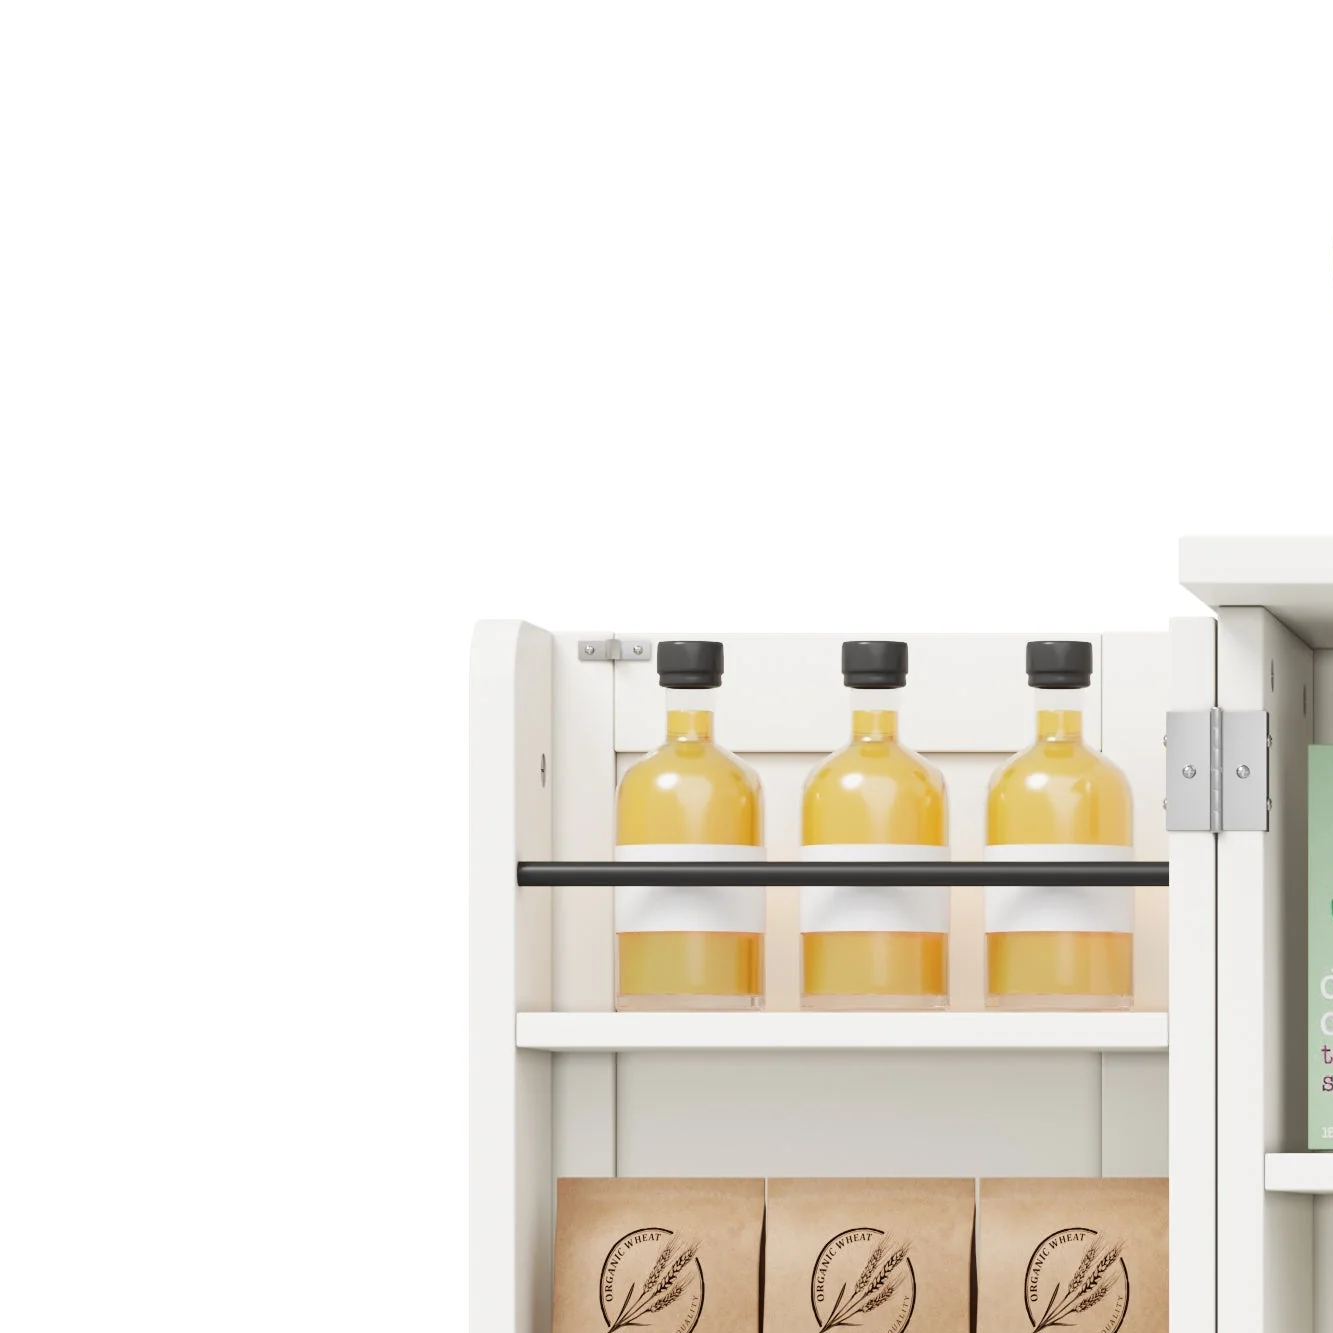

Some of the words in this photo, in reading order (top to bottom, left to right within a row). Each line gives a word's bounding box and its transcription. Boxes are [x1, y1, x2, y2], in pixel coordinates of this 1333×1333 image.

[605, 1248, 625, 1302] ORGANIC
[624, 1233, 662, 1250] WHEAT
[816, 1248, 836, 1302] ORGANIC
[835, 1233, 873, 1250] WHEAT
[1030, 1248, 1050, 1302] ORGANIC
[1050, 1233, 1088, 1250] WHEAT
